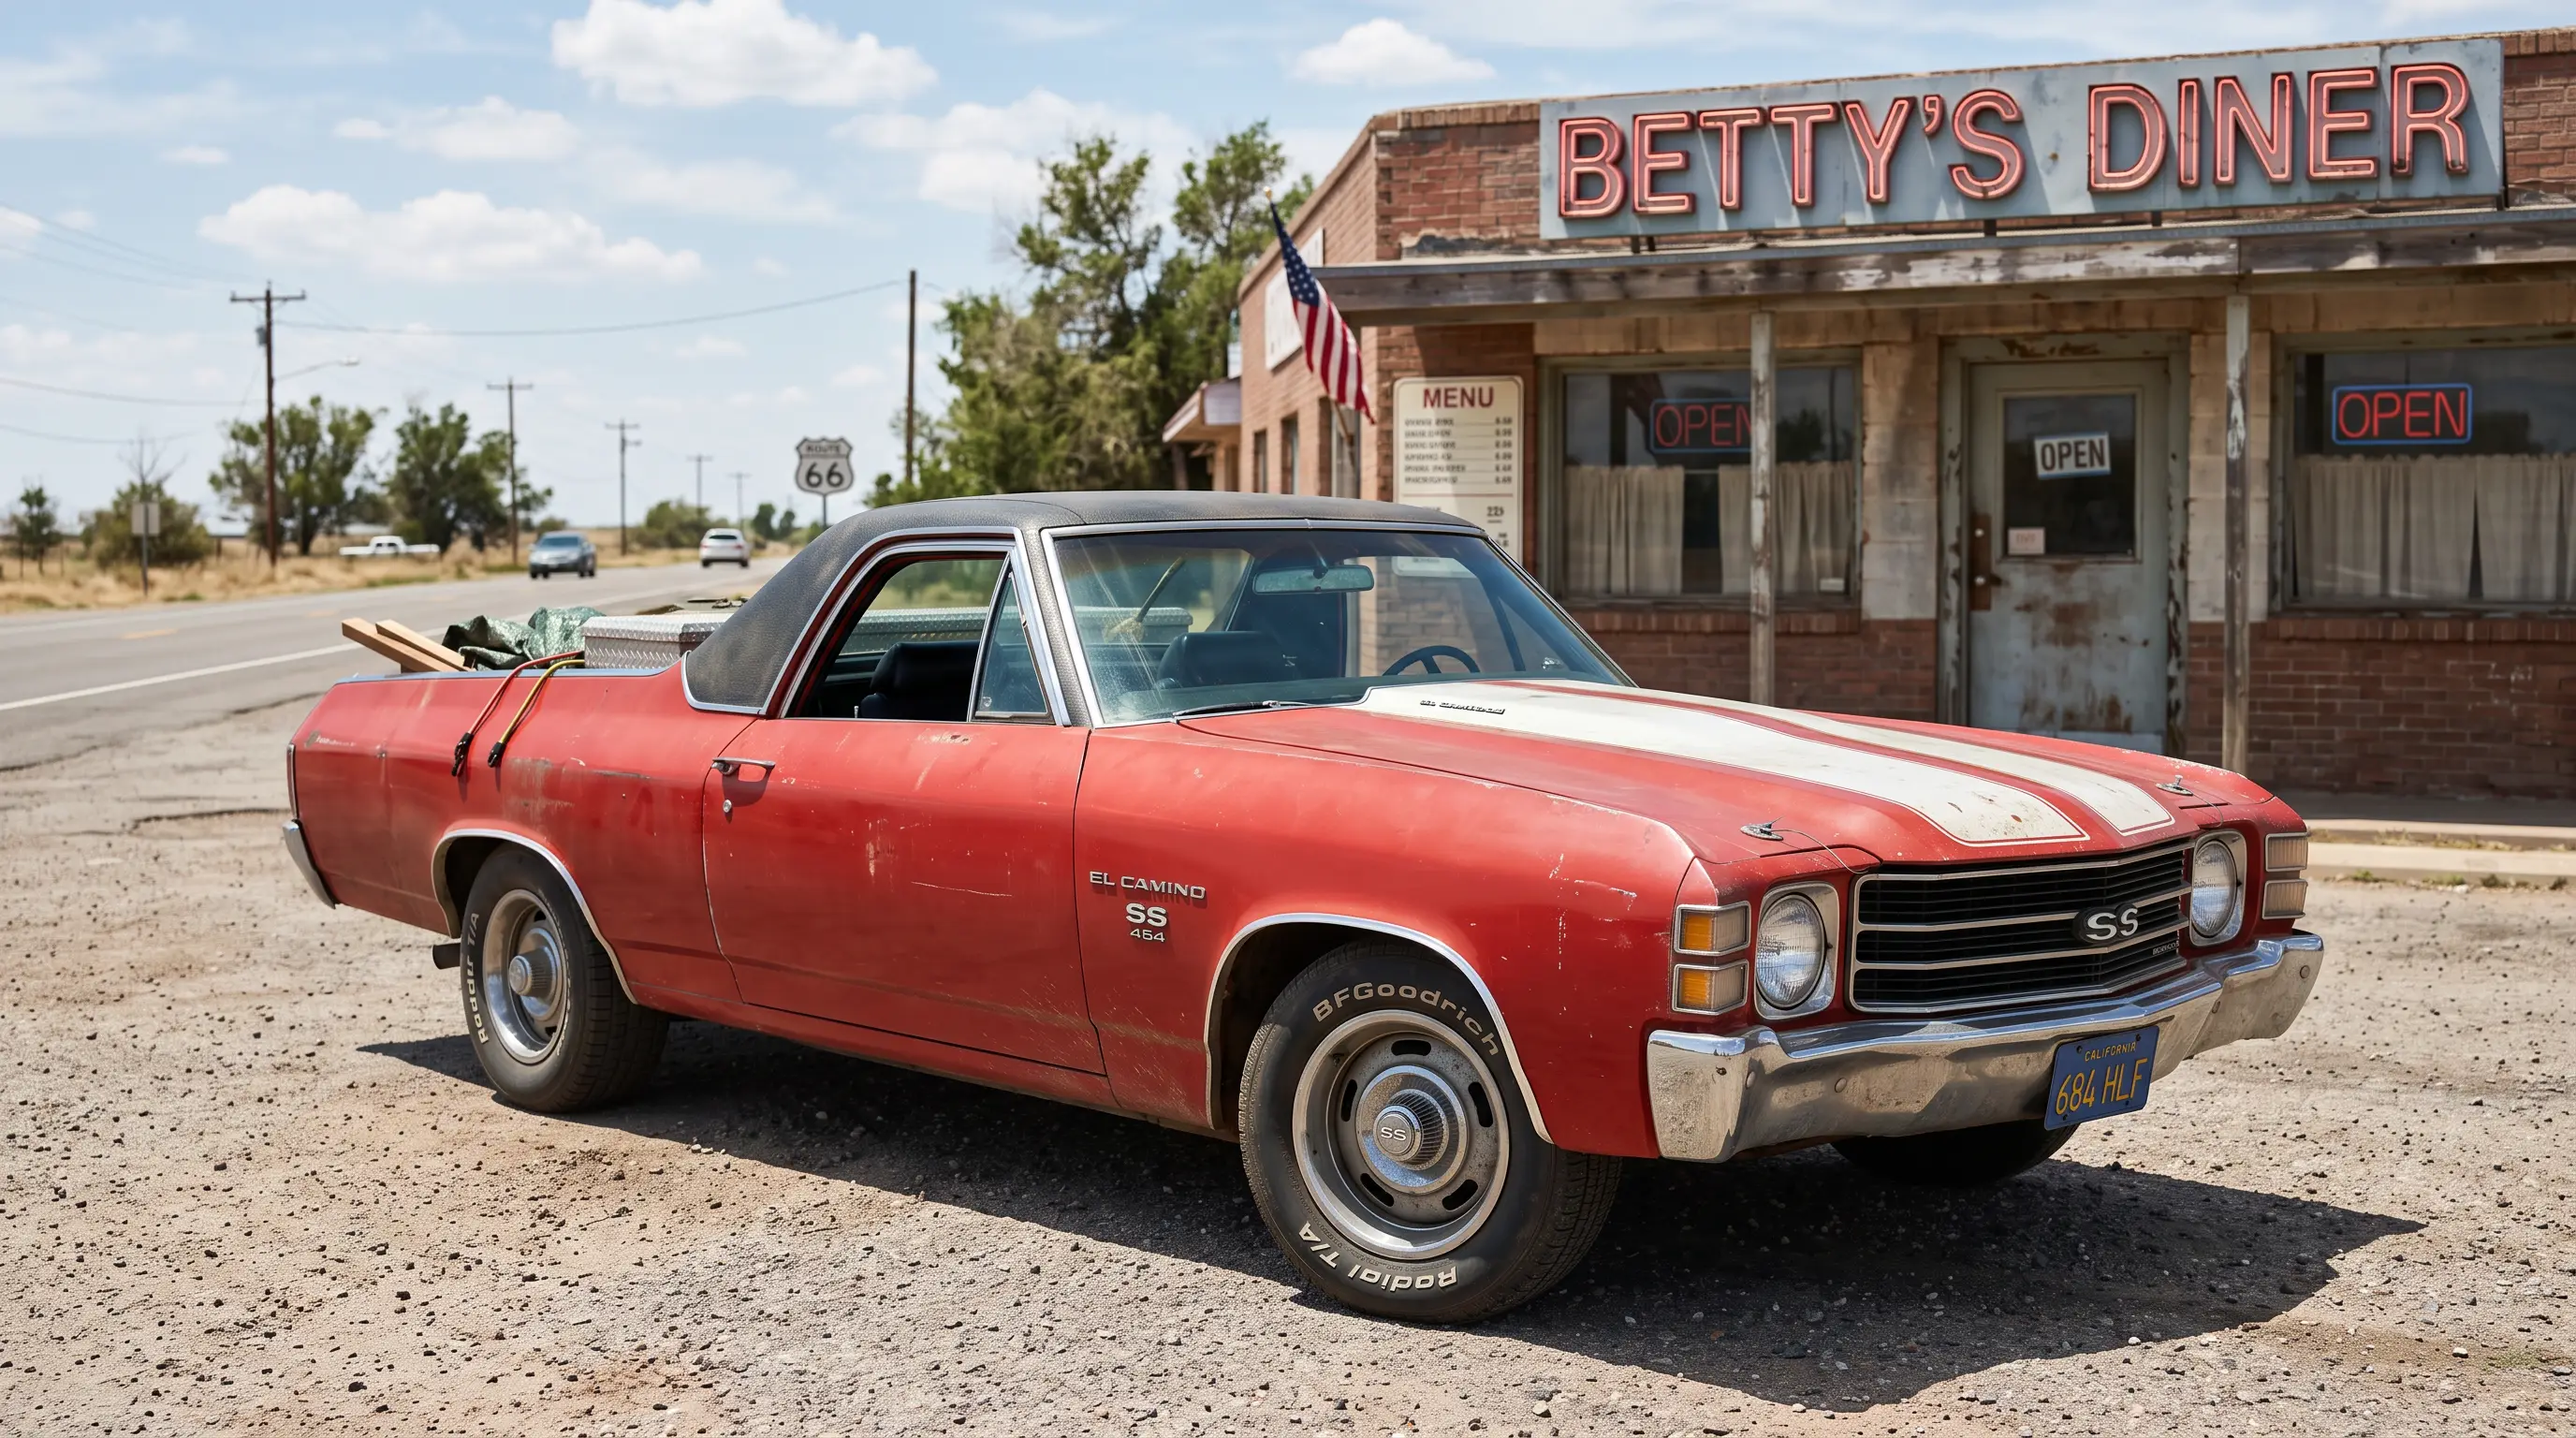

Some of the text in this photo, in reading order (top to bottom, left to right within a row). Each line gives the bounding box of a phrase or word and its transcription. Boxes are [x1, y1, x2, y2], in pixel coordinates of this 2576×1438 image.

[1558, 63, 2470, 219] BETTY'S DINER
[1423, 386, 1495, 409] MENU
[2338, 390, 2466, 438] OPEN
[2041, 438, 2105, 471] OPEN
[806, 462, 844, 488] 66
[1090, 871, 1206, 900] EL CAMINO
[1125, 902, 1167, 927] SS
[2086, 907, 2139, 941] SS
[1312, 982, 1499, 1056] BFGoodrich
[2056, 1058, 2148, 1115] 684 HLF
[1381, 1127, 1407, 1141] SS
[1298, 1221, 1340, 1269] T/A
